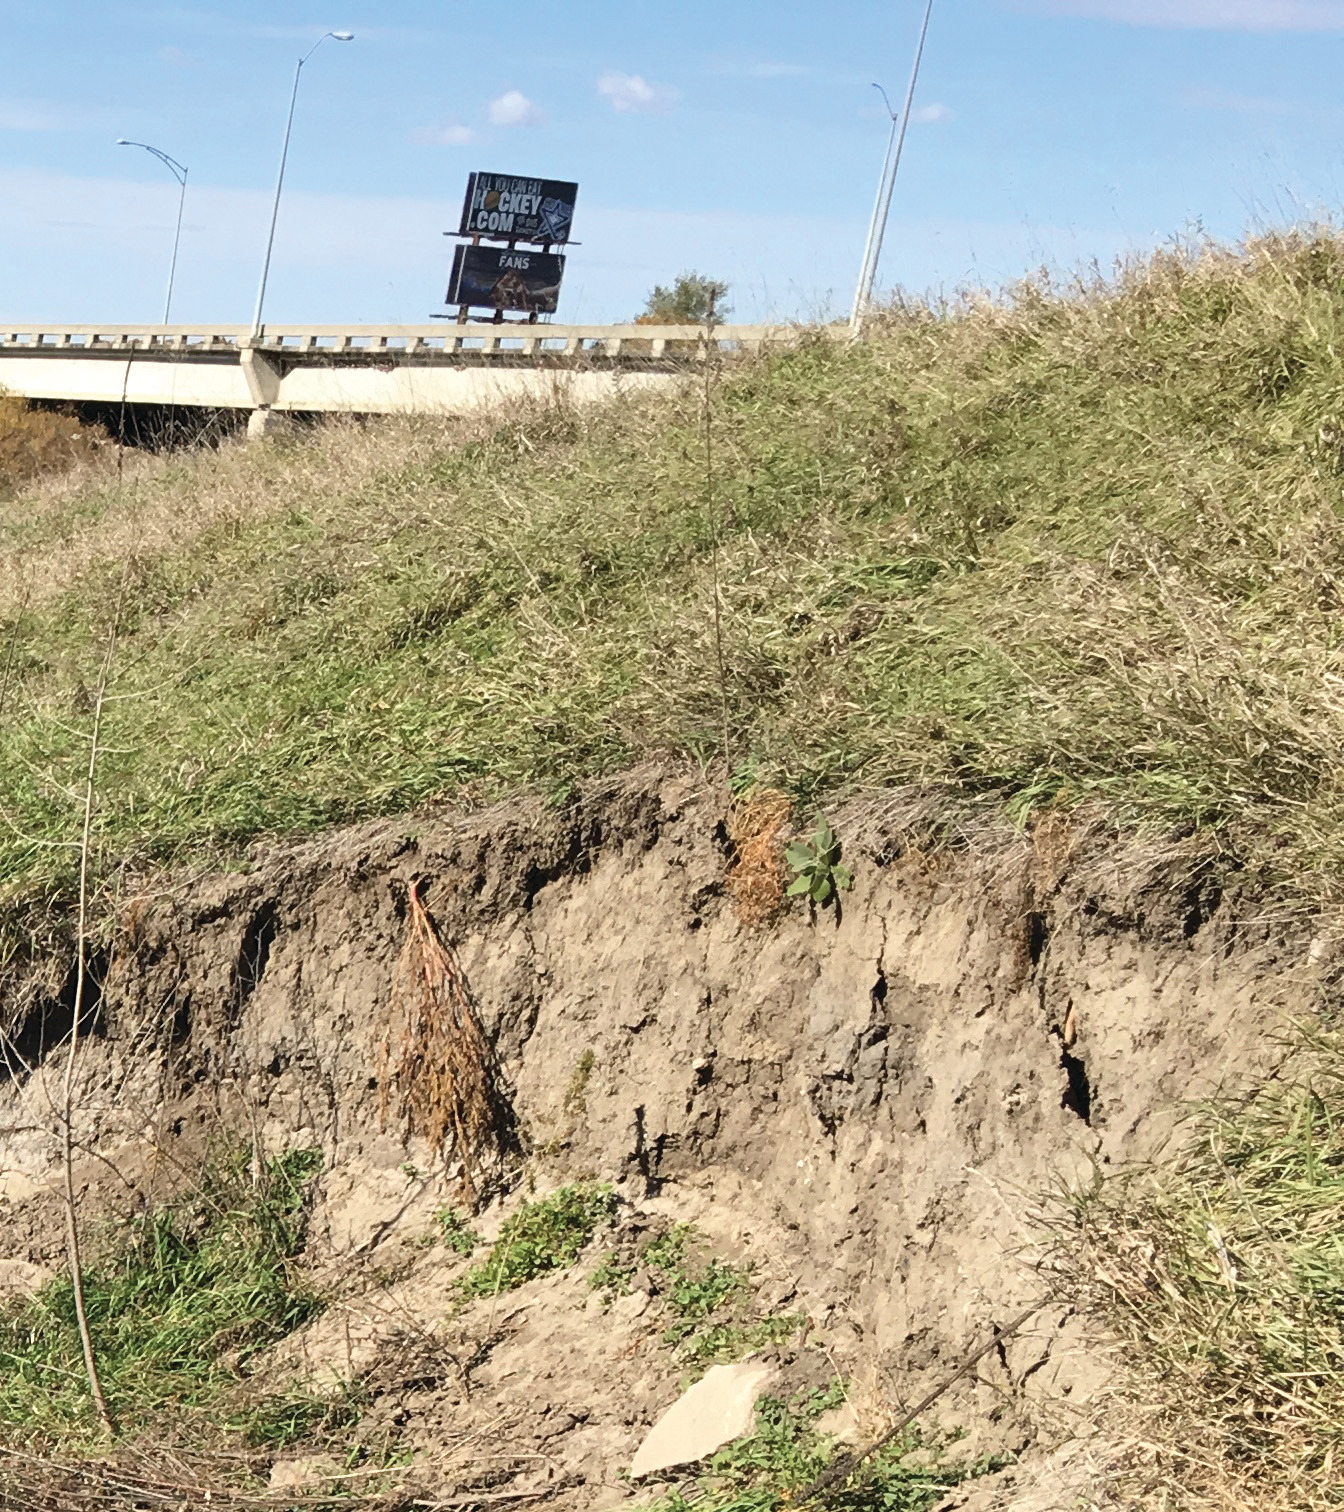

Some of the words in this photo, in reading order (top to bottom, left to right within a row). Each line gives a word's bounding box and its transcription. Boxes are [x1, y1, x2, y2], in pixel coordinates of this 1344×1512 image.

[479, 175, 491, 191] ALL
[495, 177, 510, 192] YOU
[511, 179, 528, 193] CAN
[528, 180, 543, 196] EAT
[470, 210, 515, 233] .COM
[498, 256, 531, 270] FANS
